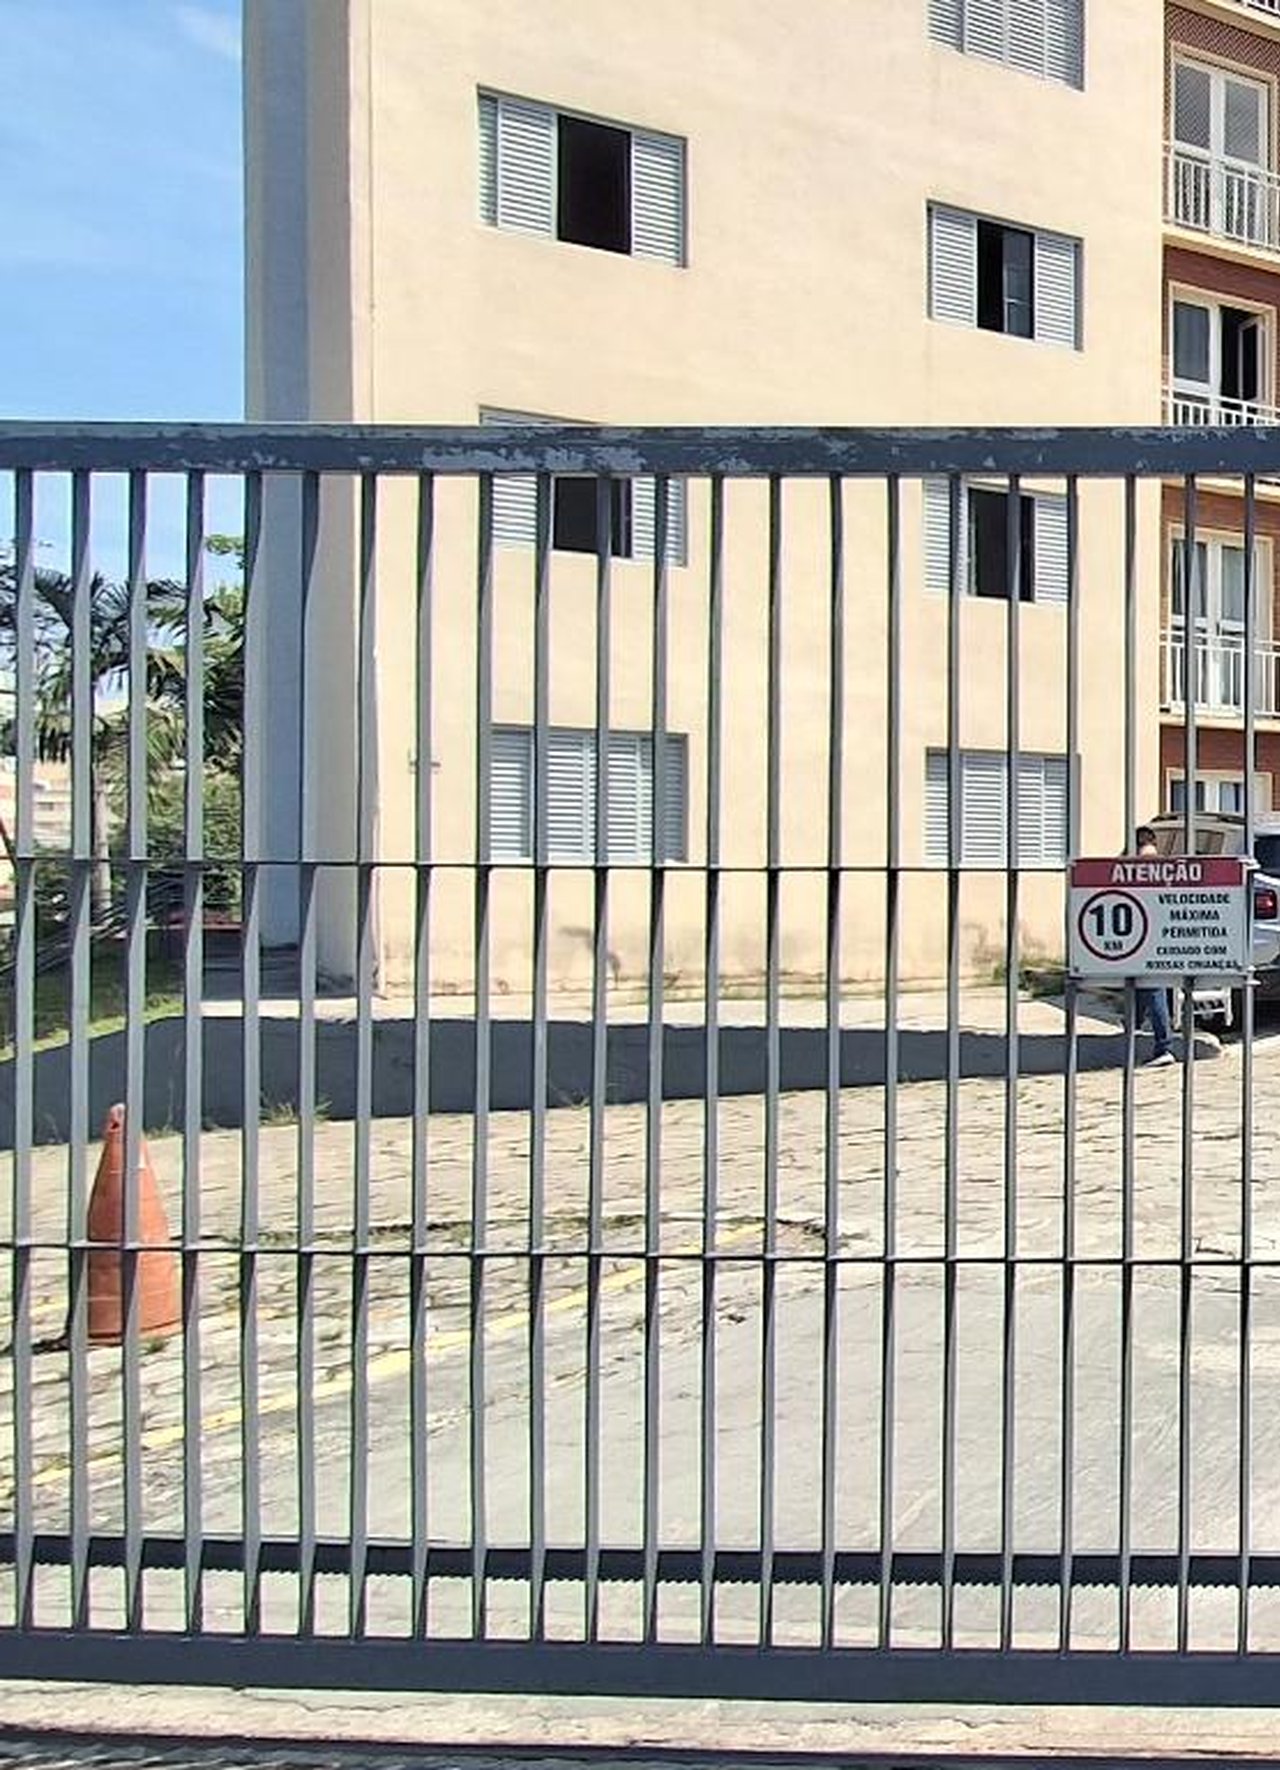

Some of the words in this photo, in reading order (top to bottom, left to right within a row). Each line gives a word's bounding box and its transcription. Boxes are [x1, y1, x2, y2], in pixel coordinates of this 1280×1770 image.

[1111, 860, 1202, 887] ATENÇÃO
[1158, 893, 1231, 905] VELOCIDADE
[1088, 903, 1133, 937] 10
[1162, 926, 1227, 938] PERMITIDA
[1103, 940, 1123, 951] KM
